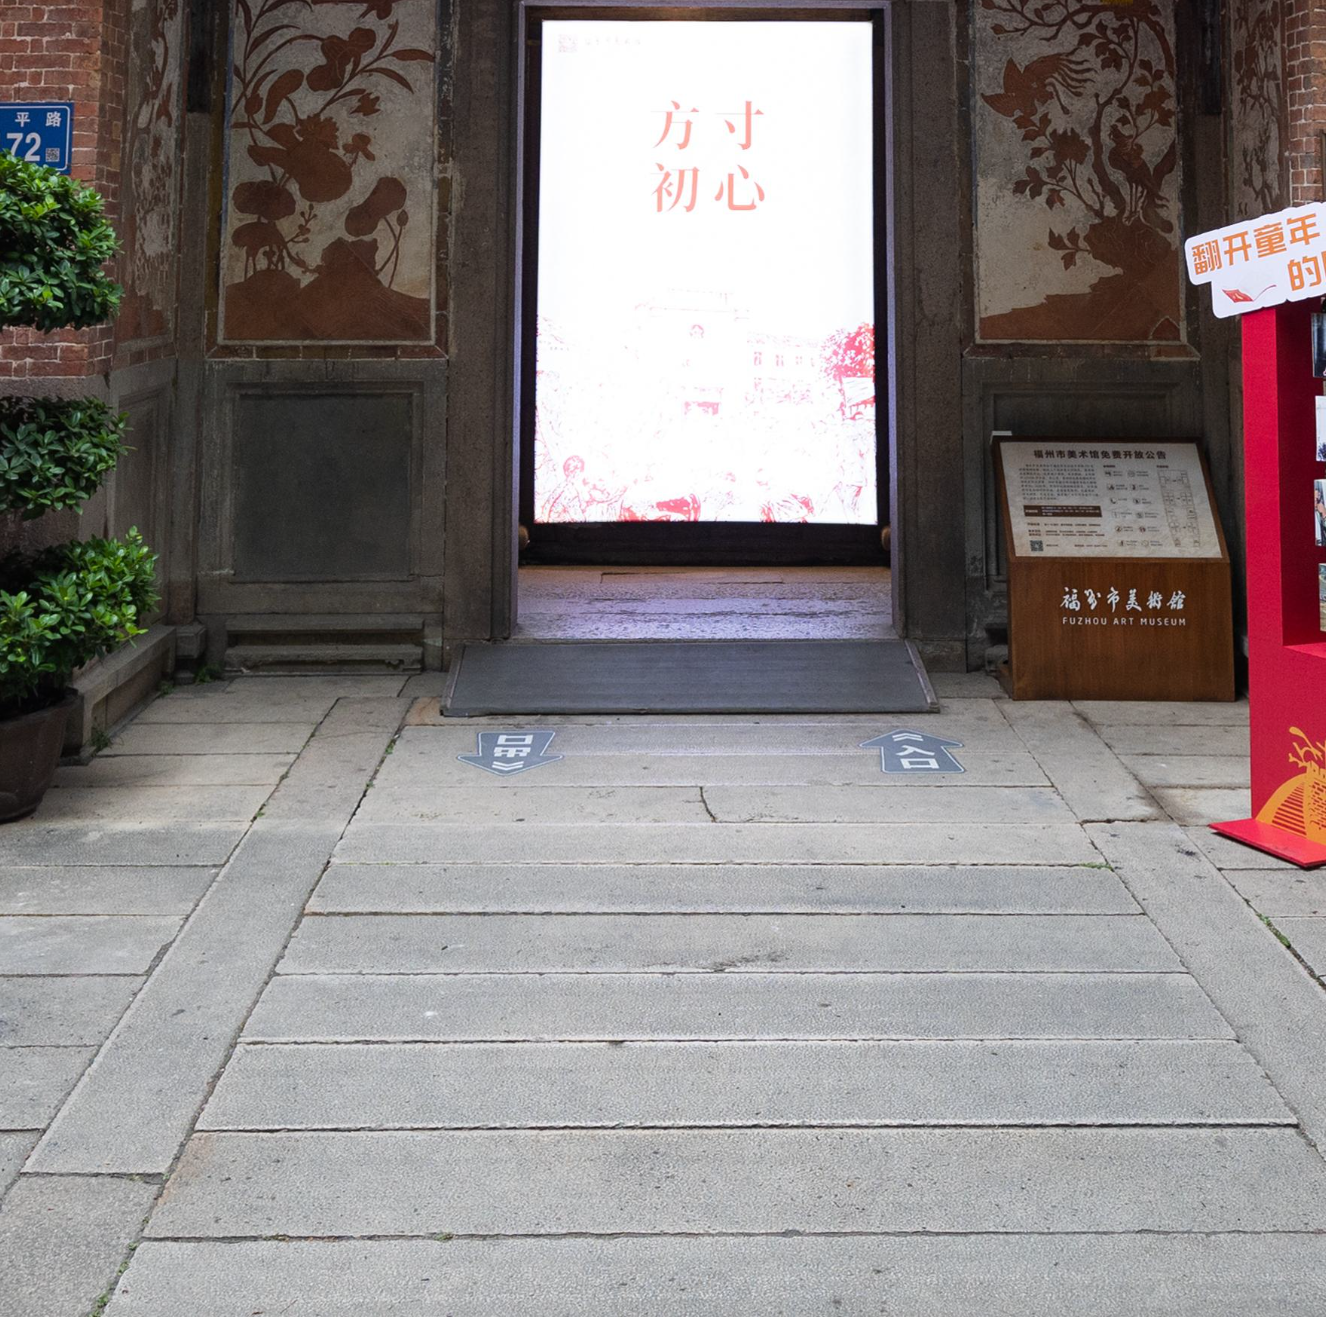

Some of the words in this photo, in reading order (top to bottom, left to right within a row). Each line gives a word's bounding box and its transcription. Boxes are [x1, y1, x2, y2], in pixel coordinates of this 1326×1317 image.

[650, 99, 765, 151] 方寸
[650, 162, 766, 213] 初心
[1192, 213, 1321, 275] 翻开童年
[1033, 449, 1167, 460] 福州市美术馆免费开放公告
[1062, 617, 1107, 625] FUZHOU
[1113, 617, 1134, 625] ART
[1140, 618, 1186, 626] MUSEUM
[493, 735, 533, 758] 出口
[895, 744, 940, 769] 入口
